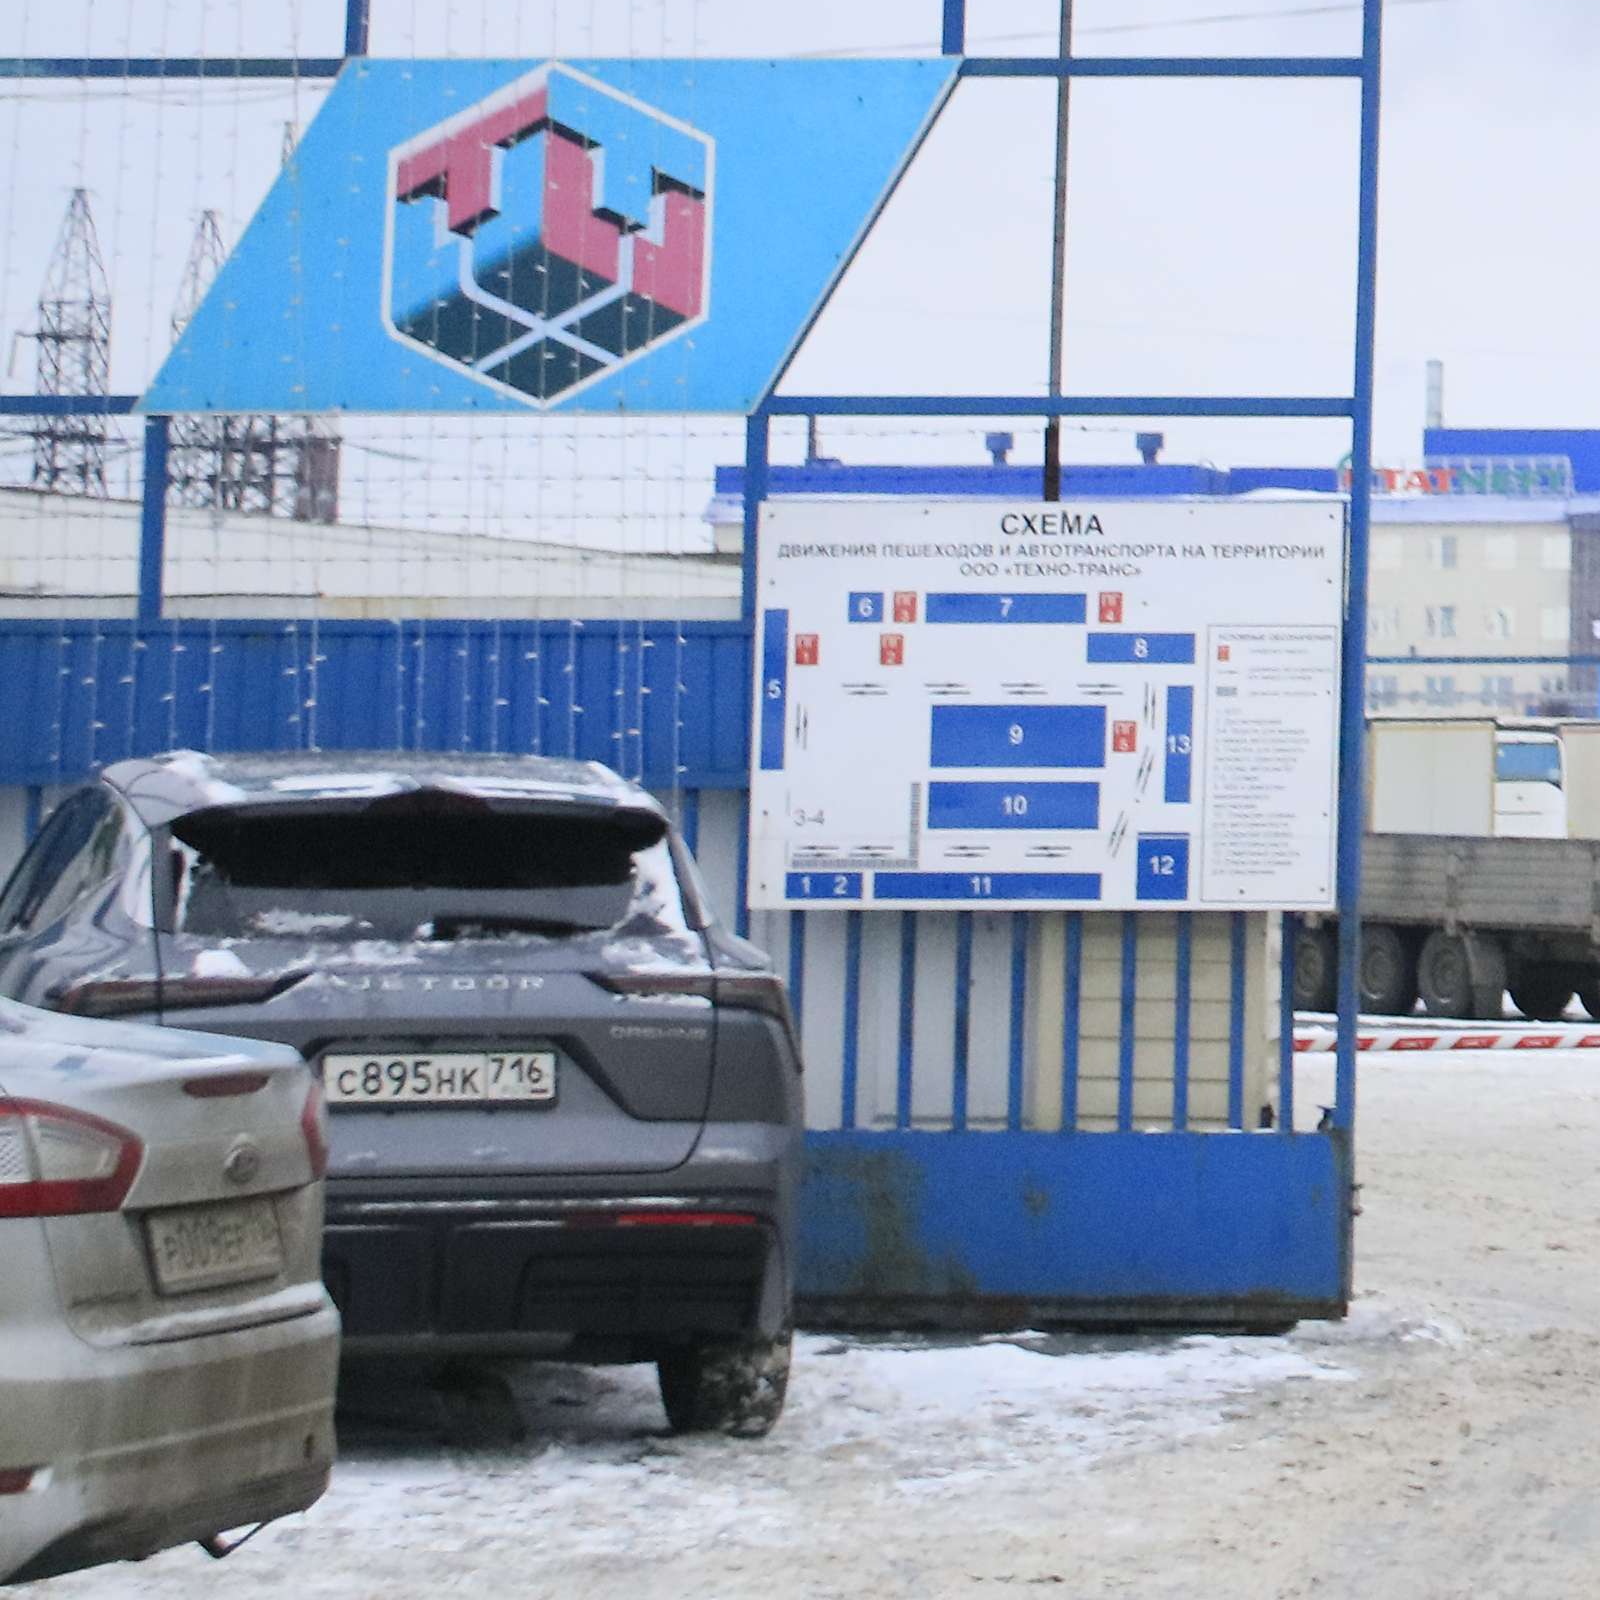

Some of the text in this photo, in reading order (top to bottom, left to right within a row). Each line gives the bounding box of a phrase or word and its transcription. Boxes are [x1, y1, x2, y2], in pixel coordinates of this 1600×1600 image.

[1000, 512, 1104, 536] СХЕМА
[777, 543, 1326, 559] ДВИЖЕНИЯ ПЕШЕХОДОВ И АВТОТРАНСПОРТА НА ТЕРРИТОРИИ
[959, 561, 1143, 577] ООО «ТЕХНО-ТРАНС»
[858, 596, 874, 618] 6
[999, 596, 1014, 618] 7
[1131, 637, 1150, 660] 8
[767, 678, 782, 700] 5
[1007, 723, 1025, 747] 9
[1167, 734, 1191, 756] 13
[1002, 795, 1028, 817] 10
[794, 809, 826, 827] 3-4
[1149, 855, 1176, 877] 12
[801, 874, 849, 896] 1 2
[969, 875, 992, 896] 11
[337, 1056, 543, 1096] С895НК 716
